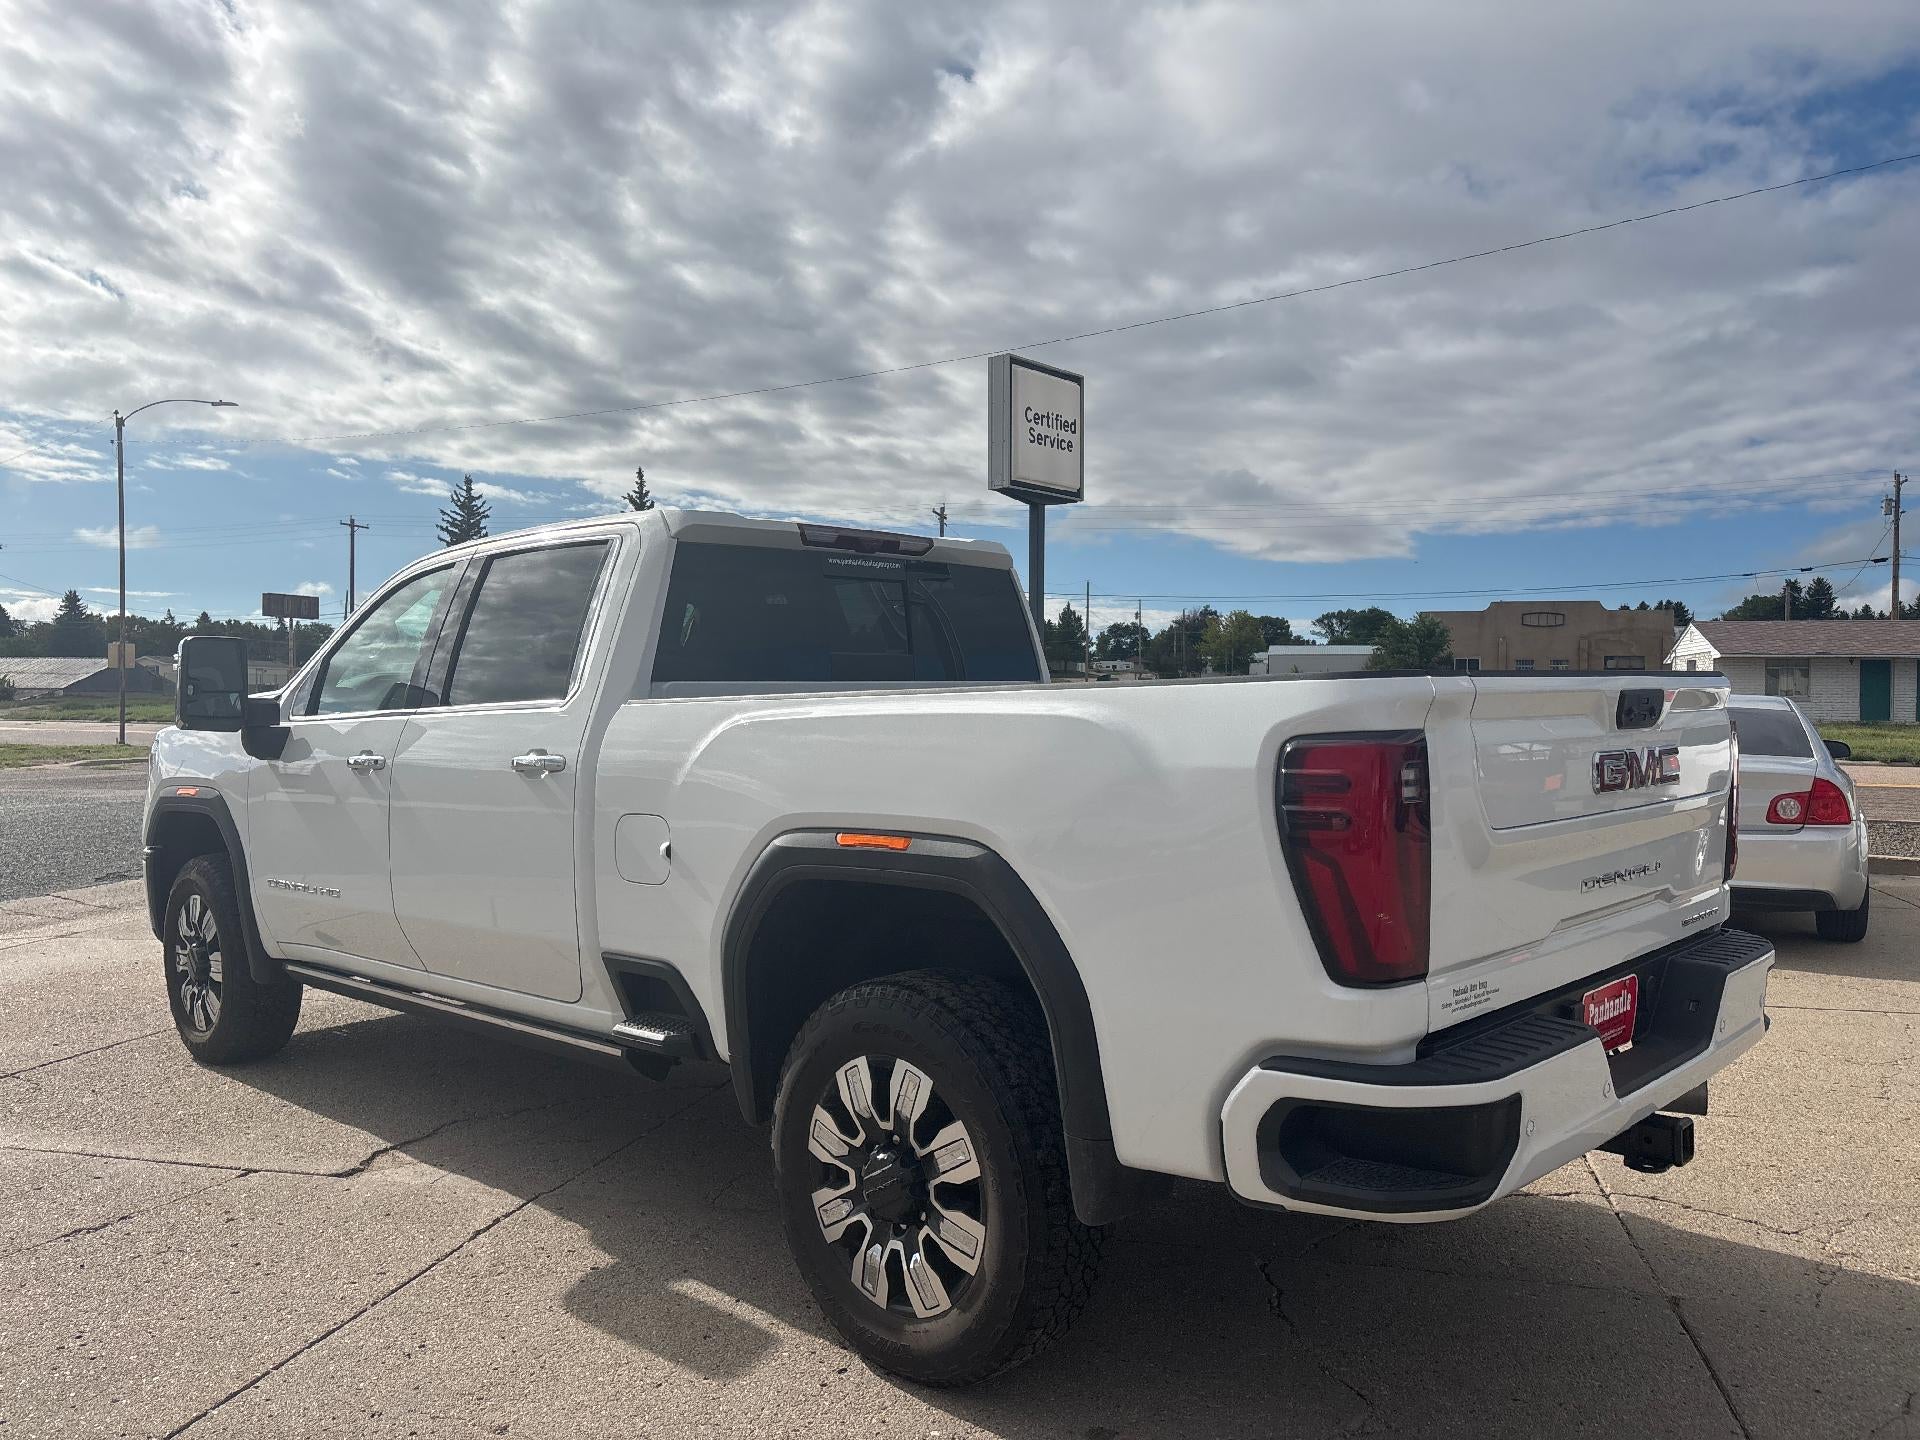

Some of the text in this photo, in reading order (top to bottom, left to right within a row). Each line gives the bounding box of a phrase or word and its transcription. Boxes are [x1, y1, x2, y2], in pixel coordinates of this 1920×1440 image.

[1024, 406, 1077, 434] Certified
[1028, 427, 1074, 452] Service
[1592, 744, 1681, 795] GMC
[1580, 860, 1661, 895] DENALI
[1588, 989, 1632, 1026] Panhandle
